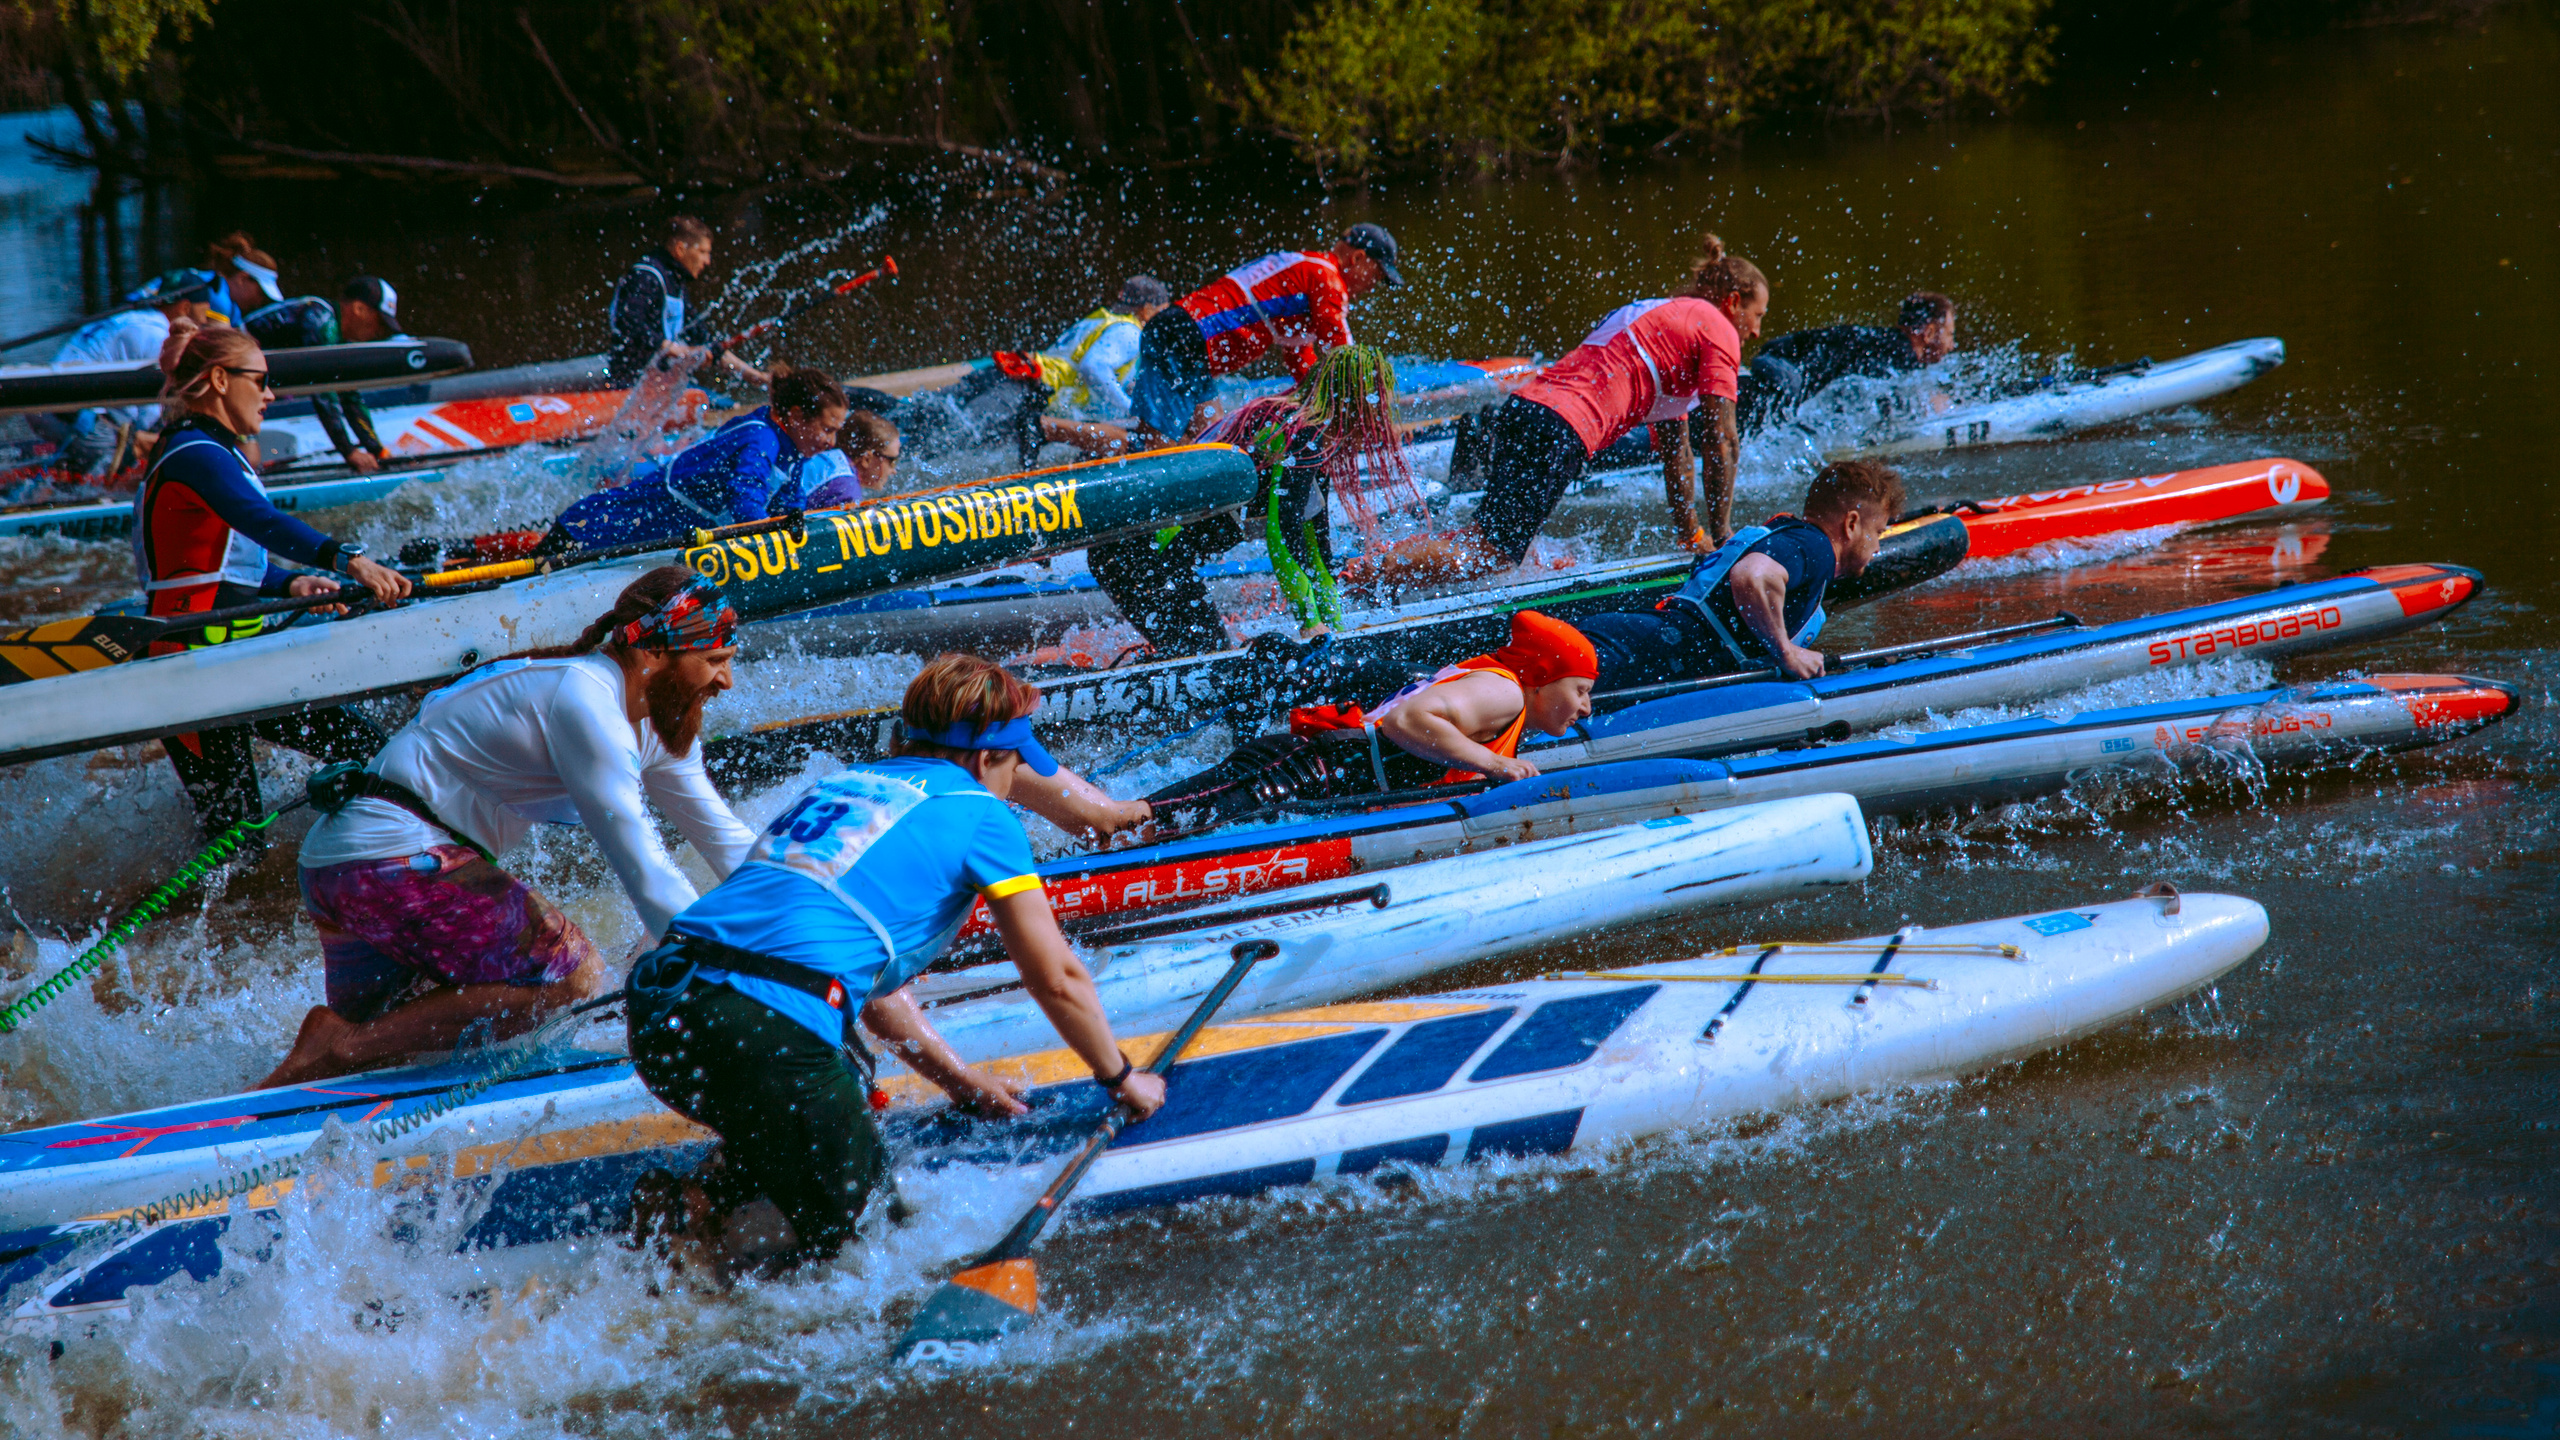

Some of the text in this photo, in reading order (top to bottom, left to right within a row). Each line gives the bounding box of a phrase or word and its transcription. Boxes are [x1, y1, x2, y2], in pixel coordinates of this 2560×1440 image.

[93, 633, 128, 658] ELITE
[2148, 605, 2342, 666] STARBOARD
[767, 795, 850, 843] 43
[1121, 849, 1309, 906] ALLSTAR
[1205, 904, 1358, 944] MELENKA
